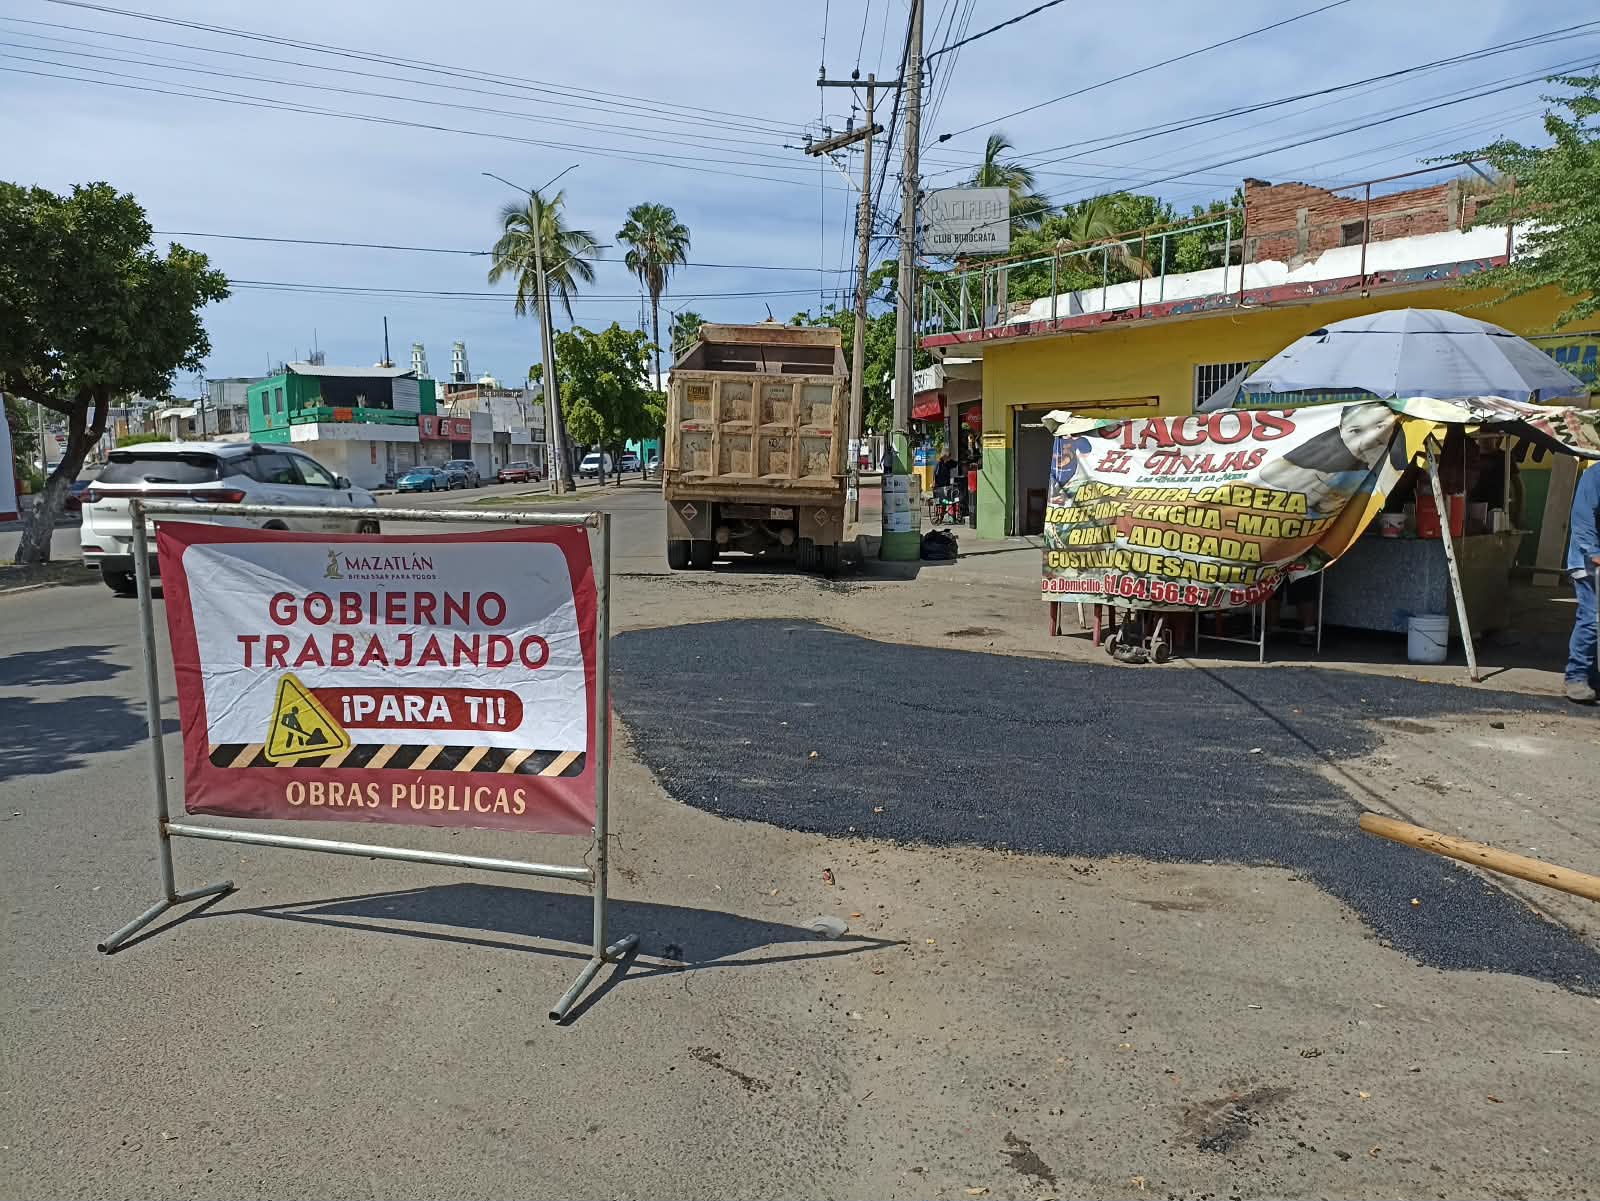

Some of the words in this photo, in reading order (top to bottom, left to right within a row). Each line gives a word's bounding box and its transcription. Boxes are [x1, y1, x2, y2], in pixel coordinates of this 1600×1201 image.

[933, 234, 952, 244] CLUB
[954, 232, 996, 243] BUROCRATA
[1098, 408, 1297, 450] TACOS
[1144, 447, 1269, 475] TINAJAS
[344, 552, 433, 571] MAZATLÁN
[1127, 525, 1262, 563] ADOBADA
[269, 591, 507, 626] GOBIERNO
[237, 633, 550, 669] TRABAJANDO
[341, 694, 453, 724] ¡PARA
[464, 696, 507, 726] TI!
[285, 780, 380, 809] OBRAS
[391, 776, 527, 815] PÚBLICAS
